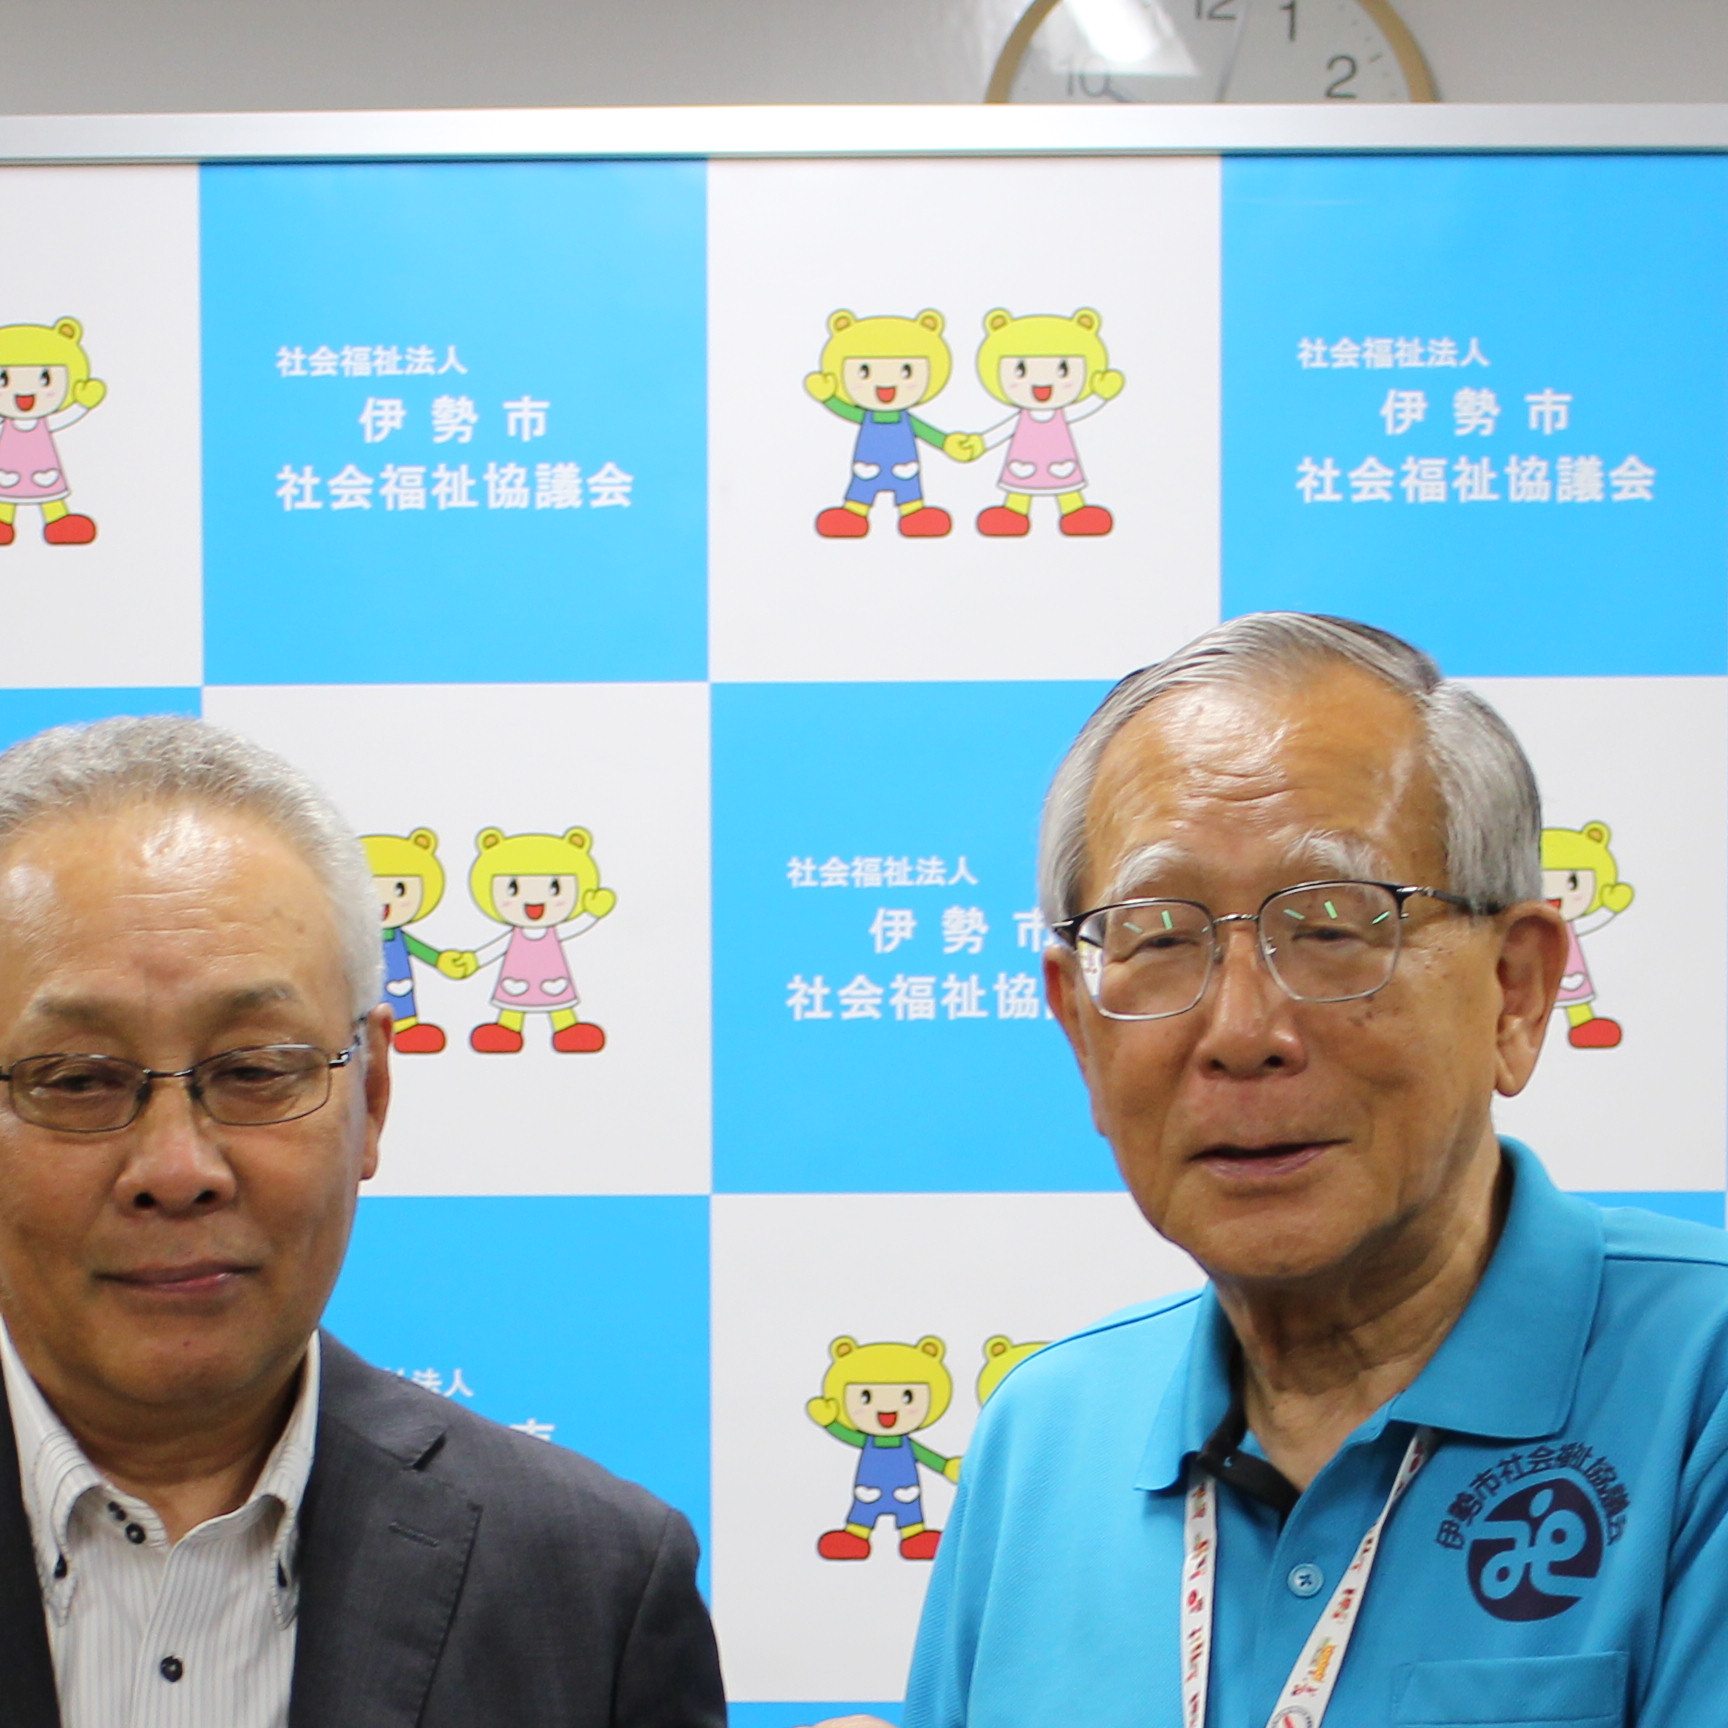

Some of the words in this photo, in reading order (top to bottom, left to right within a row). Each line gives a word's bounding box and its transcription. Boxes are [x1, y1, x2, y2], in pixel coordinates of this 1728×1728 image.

[1325, 55, 1357, 98] 2
[276, 344, 468, 376] 社会福祉法人
[1297, 337, 1490, 369] 社会福祉法人
[358, 394, 551, 443] 伊勢市
[1380, 387, 1572, 436] 伊勢市
[276, 462, 634, 511] 社会福祉協議会
[1296, 456, 1655, 503] 社会福祉協議会
[787, 856, 978, 888] 社会福祉法人
[786, 973, 1054, 1020] 社会福祉協
[383, 1367, 474, 1398] 法人
